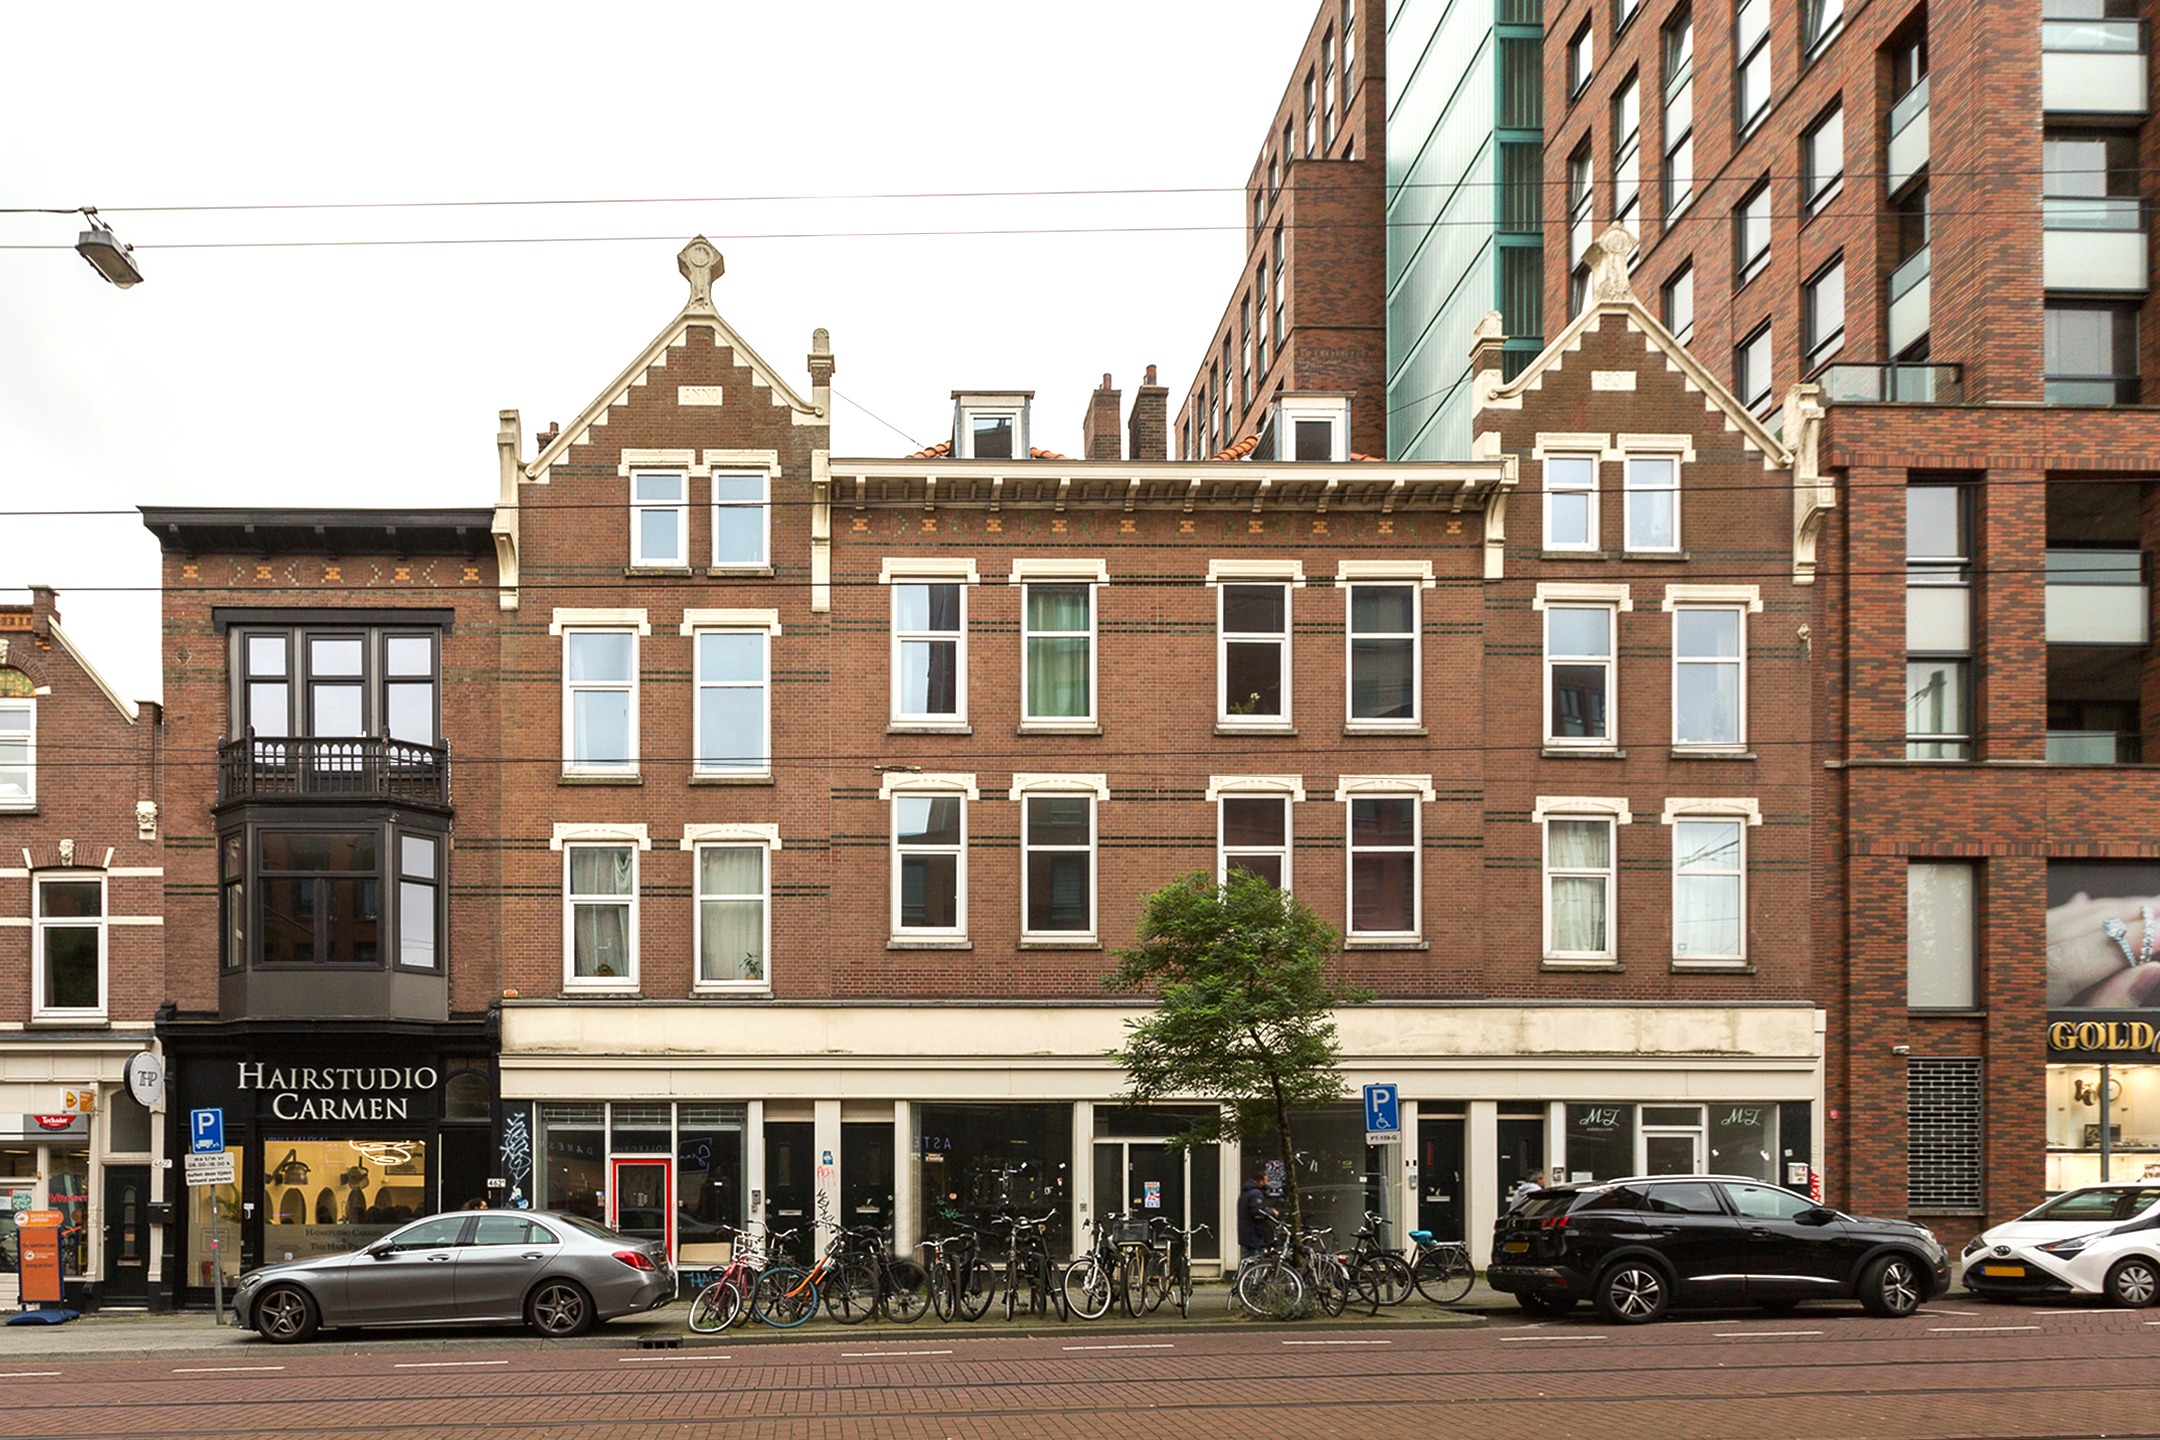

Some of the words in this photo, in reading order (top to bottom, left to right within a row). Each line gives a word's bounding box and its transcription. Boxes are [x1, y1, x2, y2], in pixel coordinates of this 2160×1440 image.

[2048, 1020, 2160, 1052] GOLD
[237, 1062, 438, 1091] HAIRSTUDIO
[272, 1092, 408, 1120] CARMEN
[1372, 1089, 1390, 1113] P
[198, 1112, 215, 1135] P
